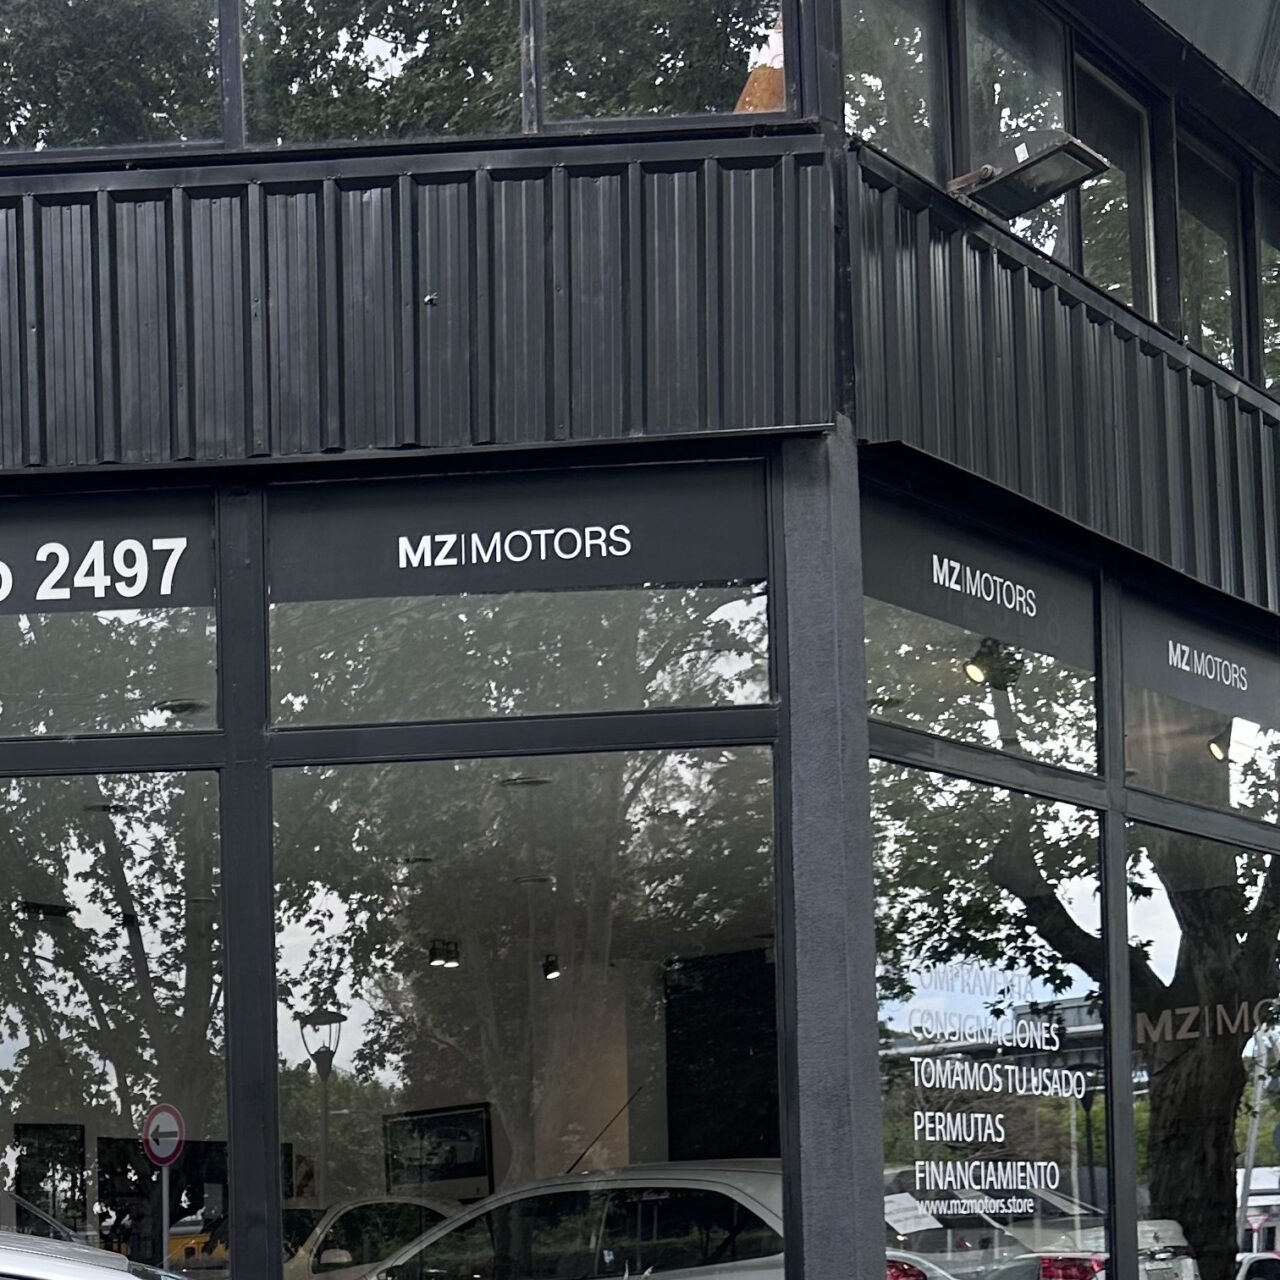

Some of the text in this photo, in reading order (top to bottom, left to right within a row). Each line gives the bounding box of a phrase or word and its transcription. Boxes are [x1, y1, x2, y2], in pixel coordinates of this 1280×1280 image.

[34, 536, 188, 601] 2497
[908, 1007, 1061, 1051] CONSIGNACIONES
[910, 1056, 1086, 1099] TOMAMOS TU USADO
[913, 1110, 1006, 1143] PERMUTAS
[914, 1160, 1061, 1191] FINANCIAMIENTO
[916, 1195, 1035, 1215] www.mzmotors.store
